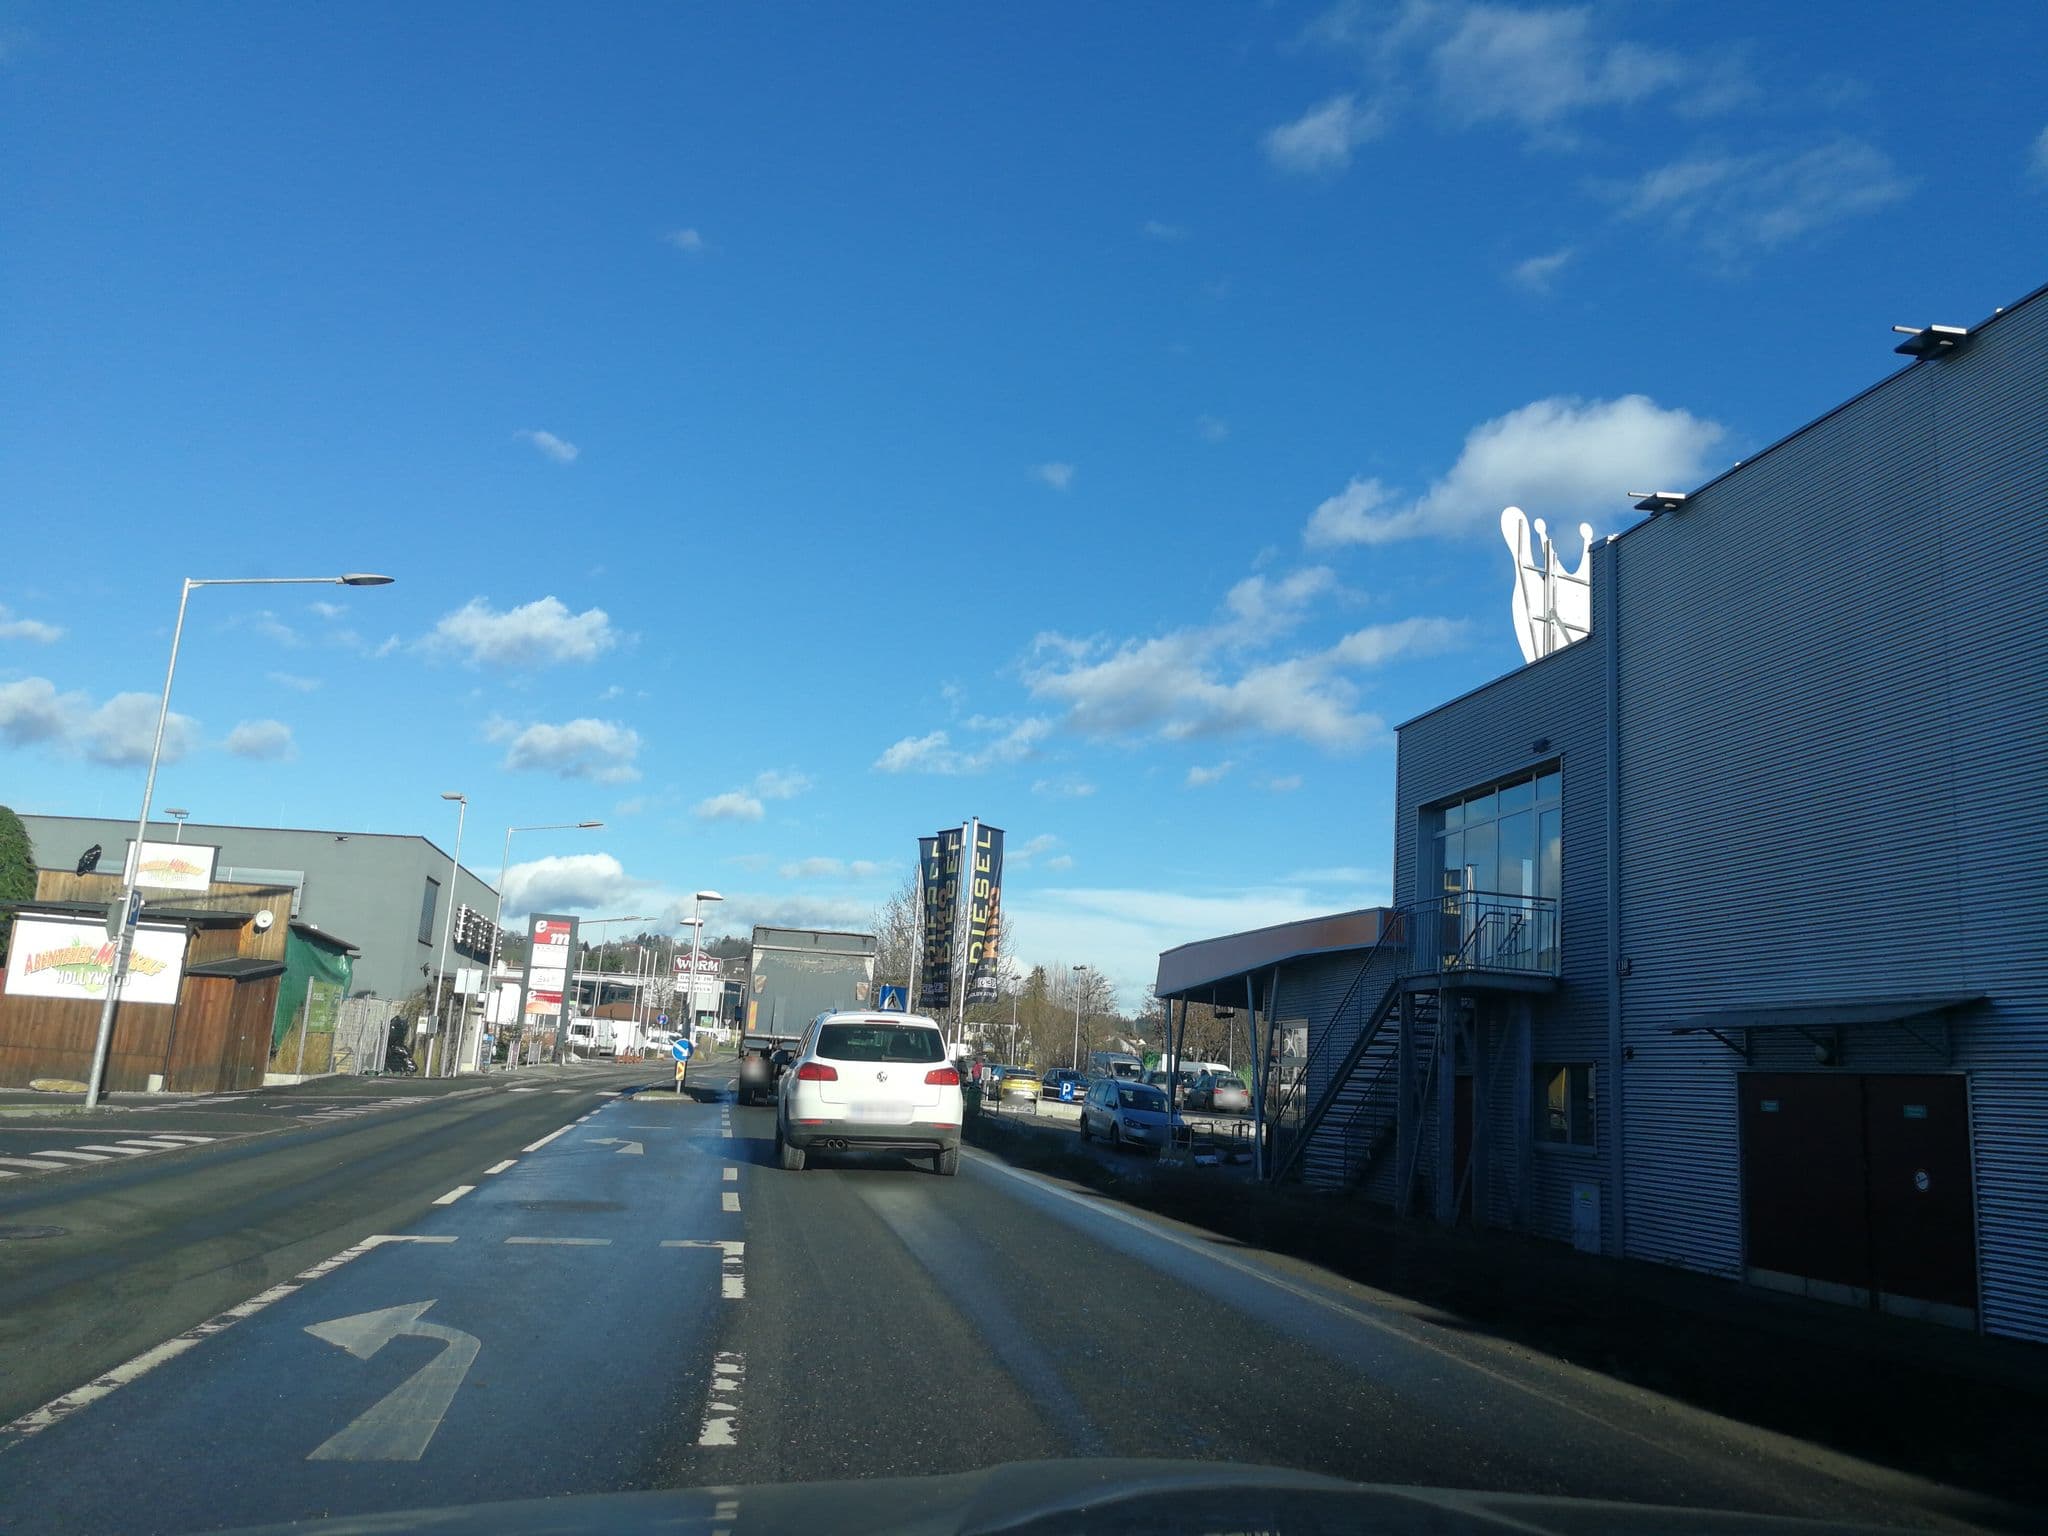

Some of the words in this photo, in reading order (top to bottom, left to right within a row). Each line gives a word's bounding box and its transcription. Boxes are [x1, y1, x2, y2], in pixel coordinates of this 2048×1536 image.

[970, 830, 991, 964] DIESEL
[56, 970, 131, 986] HOLLYWD
[1062, 1083, 1071, 1096] P
